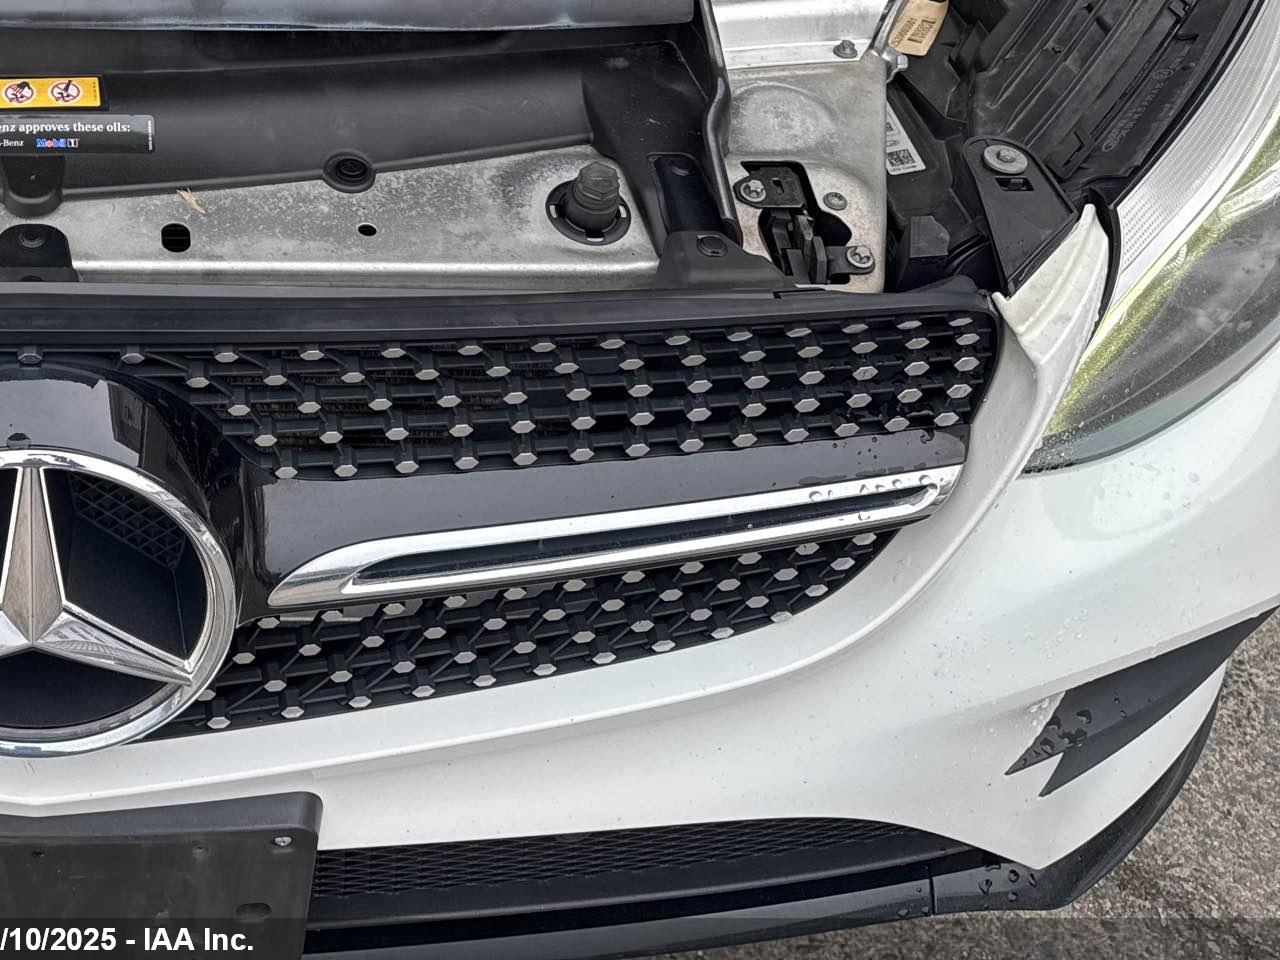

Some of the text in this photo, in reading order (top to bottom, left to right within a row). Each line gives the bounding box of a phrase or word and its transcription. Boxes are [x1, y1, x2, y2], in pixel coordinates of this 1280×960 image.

[19, 123, 70, 135] approves
[73, 122, 104, 133] these
[106, 121, 131, 133] oils:
